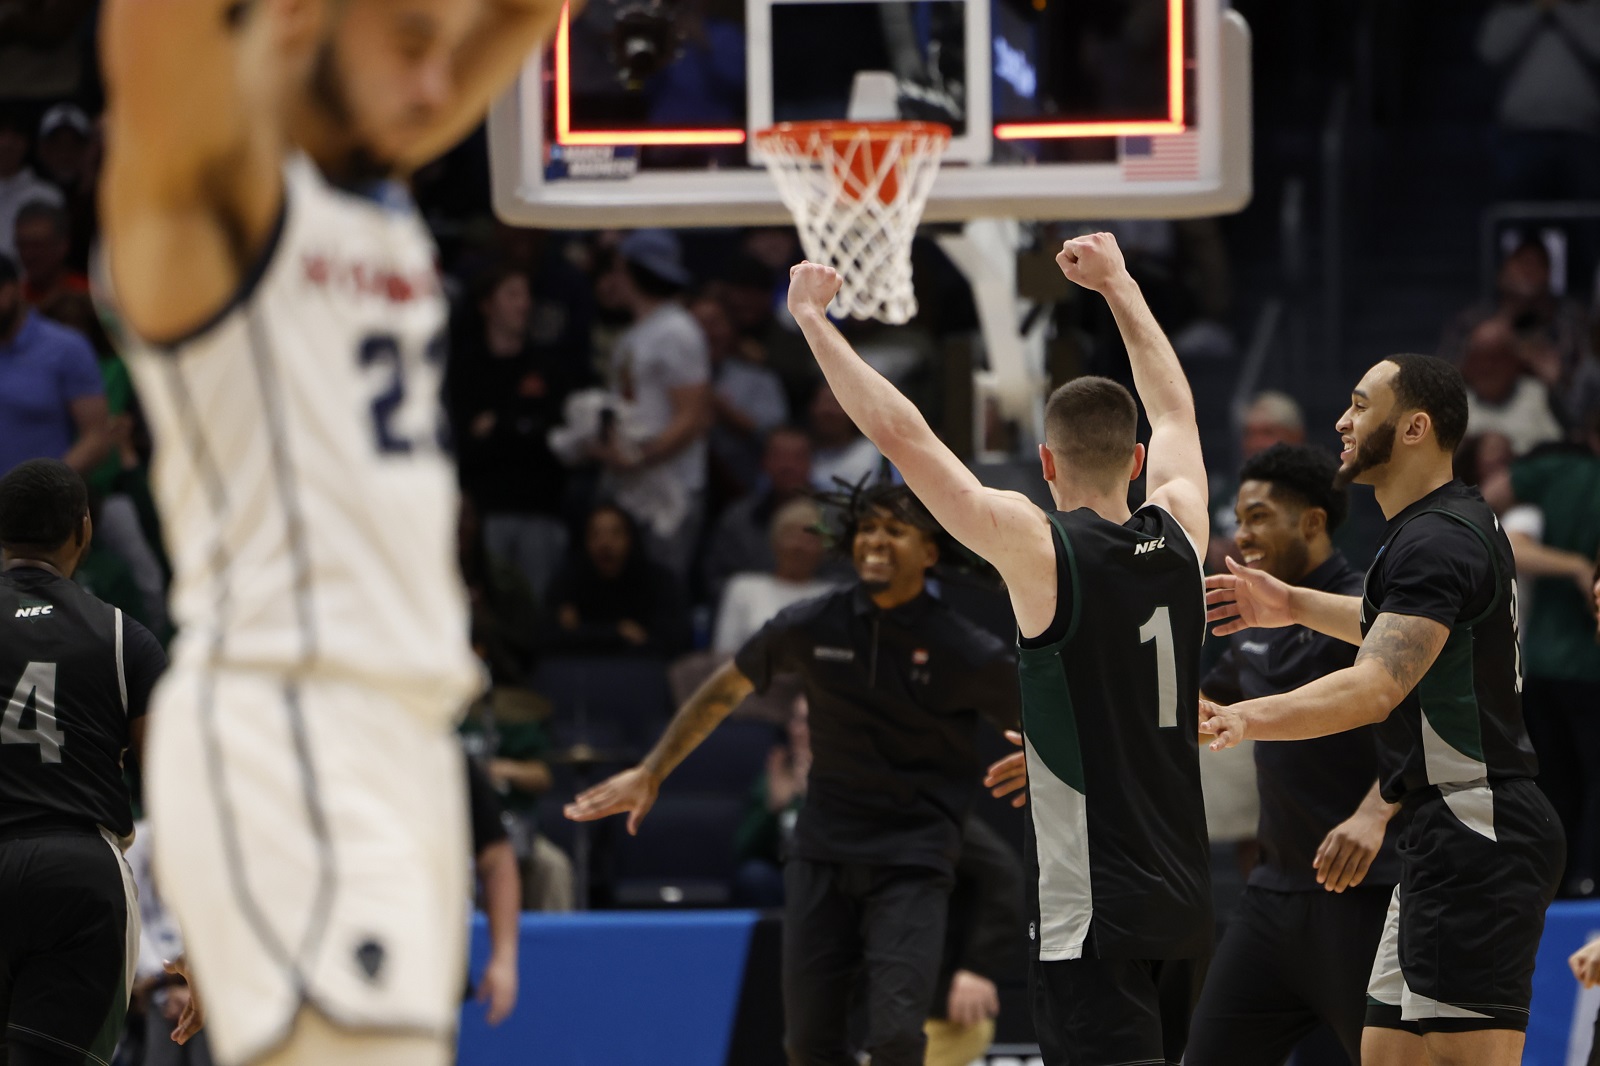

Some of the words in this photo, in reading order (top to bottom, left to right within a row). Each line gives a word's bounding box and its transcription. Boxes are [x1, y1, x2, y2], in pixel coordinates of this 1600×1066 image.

[1134, 536, 1166, 556] NEC
[14, 604, 54, 618] NEC
[1139, 606, 1178, 728] 1
[0, 661, 65, 764] 4
